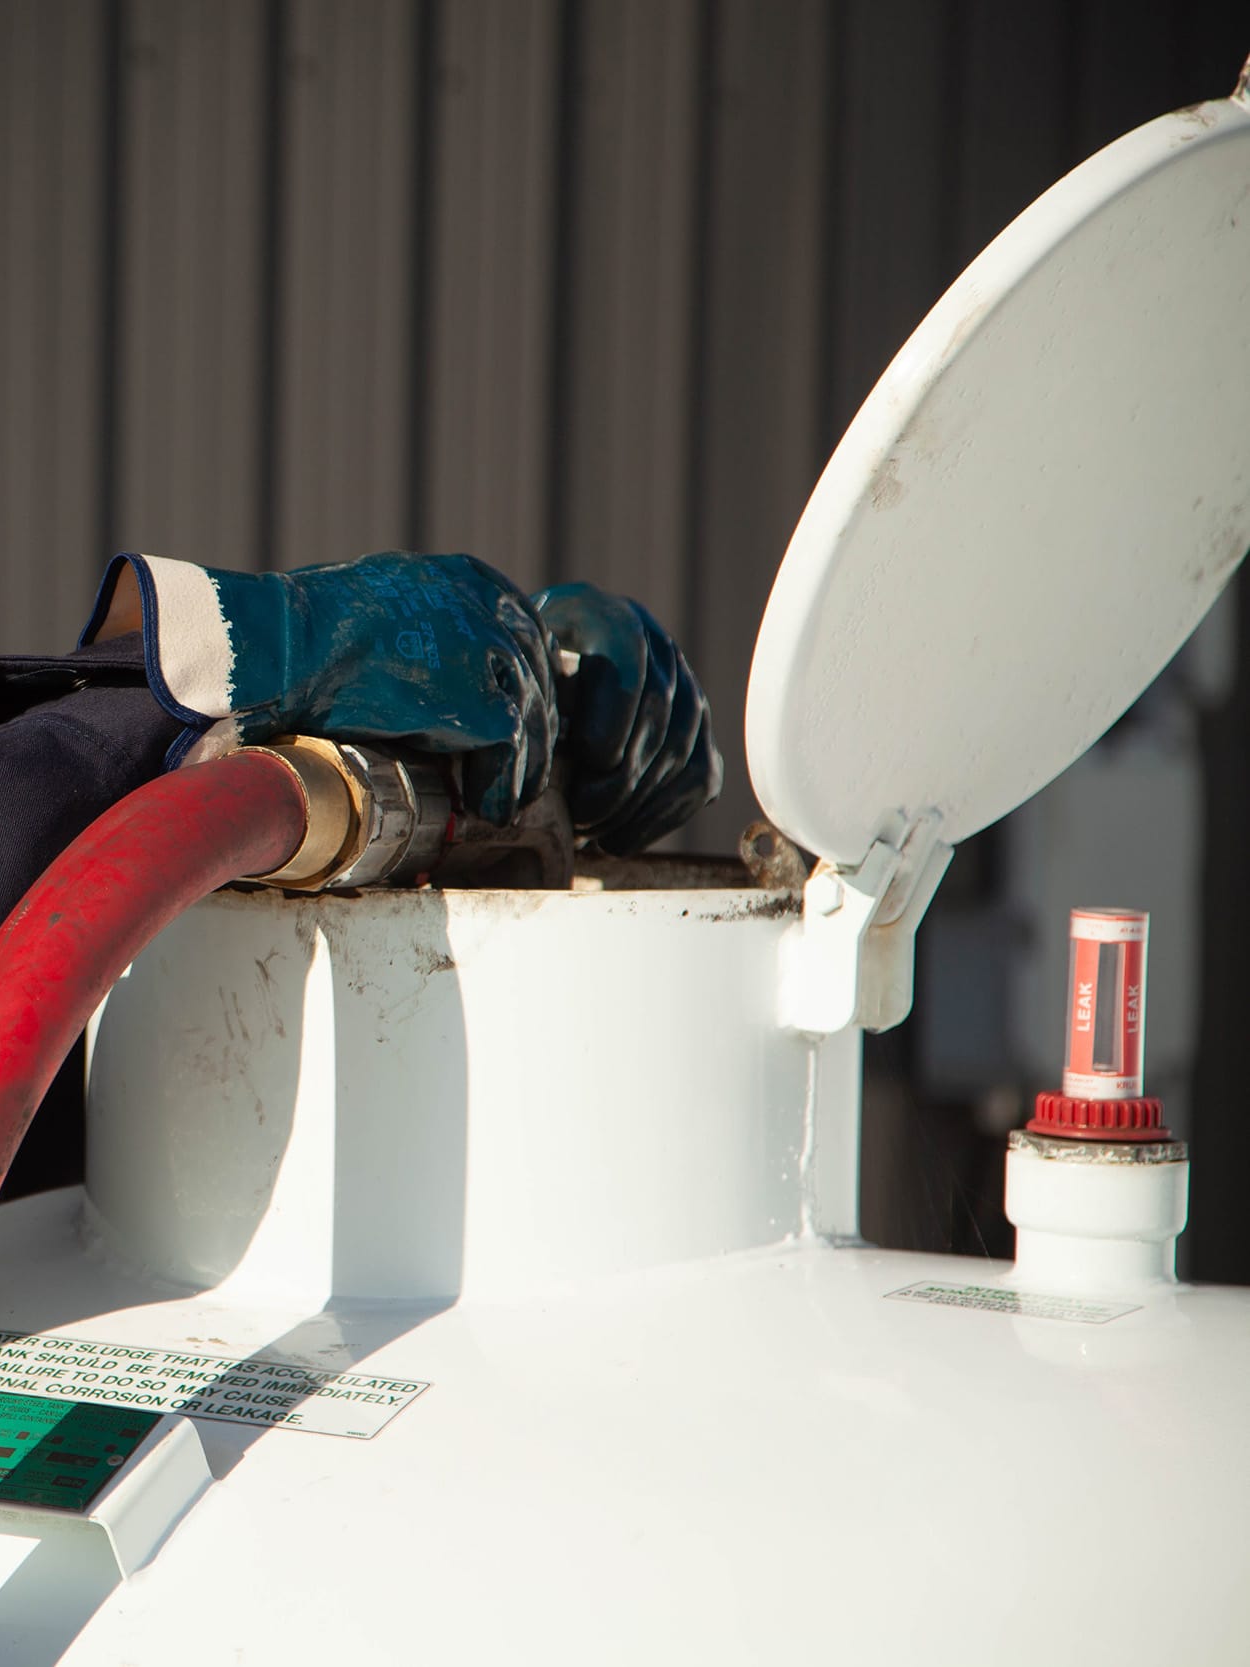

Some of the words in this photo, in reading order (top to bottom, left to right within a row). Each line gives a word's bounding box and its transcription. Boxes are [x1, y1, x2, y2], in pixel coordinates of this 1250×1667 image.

[1077, 982, 1092, 1032] LEAK
[1127, 984, 1139, 1033] LEAK
[34, 1352, 118, 1369] SHOULD
[126, 1363, 157, 1375] BE
[157, 1367, 259, 1387] REMOVED
[261, 1380, 404, 1406] IMMEDIATELY.
[43, 1339, 73, 1350] OR
[75, 1344, 160, 1360] SLUDGE
[162, 1354, 214, 1367] THAT
[215, 1361, 259, 1374] HAS
[259, 1366, 418, 1393] ACCUMULATED
[72, 1371, 99, 1382] TO
[101, 1375, 134, 1386] DO
[136, 1379, 167, 1391] SO
[174, 1384, 222, 1398] MAY
[223, 1390, 298, 1408] CAUSE
[45, 1383, 168, 1406] CORROSION
[170, 1399, 203, 1411] OR
[204, 1403, 304, 1425] LEAKAGE.
